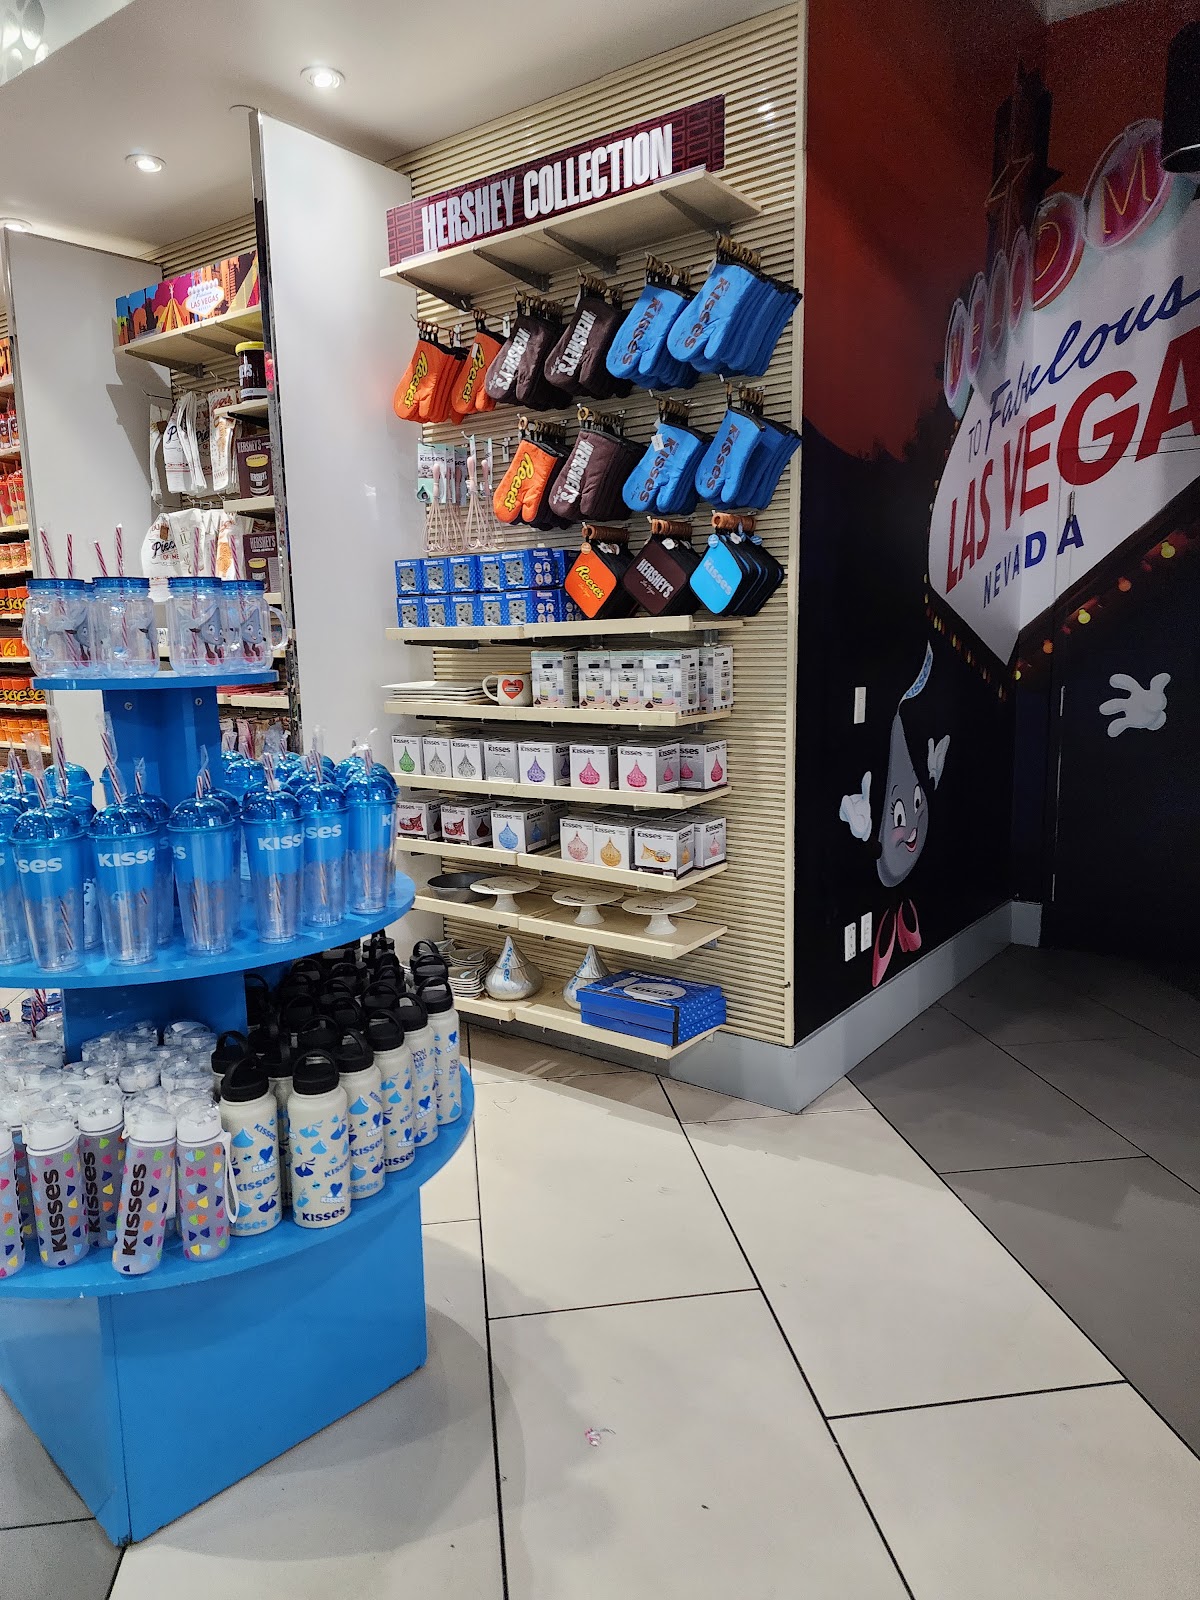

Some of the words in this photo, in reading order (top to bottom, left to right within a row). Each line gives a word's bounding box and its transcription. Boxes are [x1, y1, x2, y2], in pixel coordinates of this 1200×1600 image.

[421, 176, 515, 252] HERSHEY
[523, 123, 673, 220] COLLECTION
[200, 294, 219, 306] VEGAS
[985, 275, 1200, 456] Fabulous
[945, 458, 994, 595] LAS
[1003, 326, 1200, 531] VEGA
[968, 419, 982, 463] TO
[152, 540, 176, 559] Piec
[983, 514, 1085, 609] NEVADA
[575, 564, 605, 600] Reese's
[636, 558, 675, 598] HERSHEY'S
